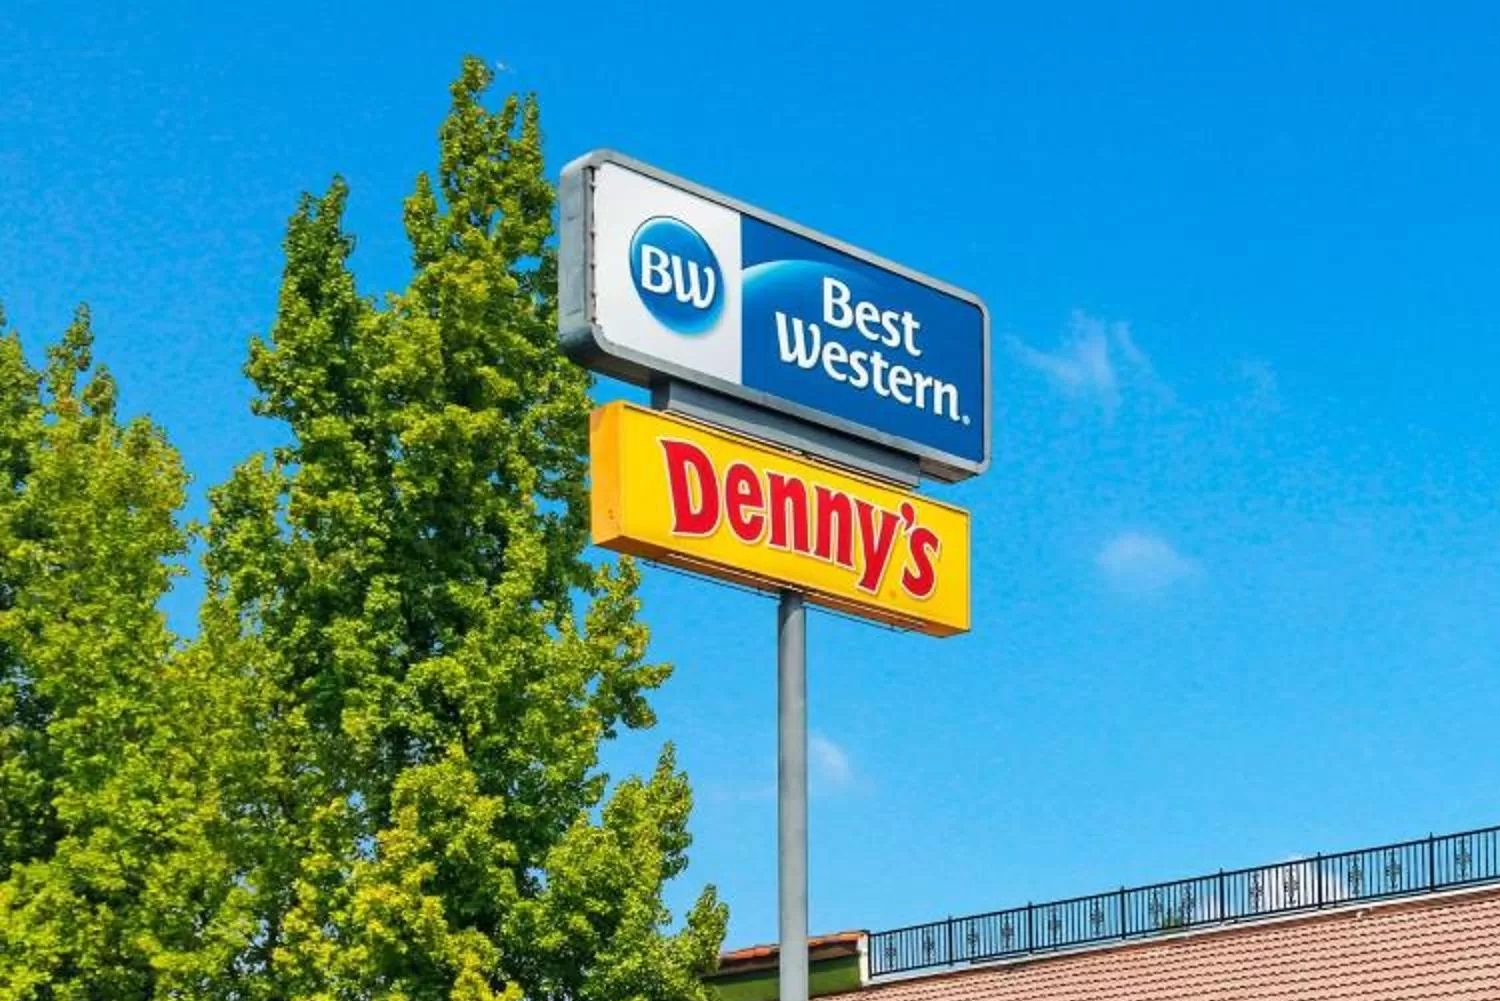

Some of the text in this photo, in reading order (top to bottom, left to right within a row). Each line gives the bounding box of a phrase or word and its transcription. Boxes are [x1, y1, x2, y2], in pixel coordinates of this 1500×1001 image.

[639, 244, 717, 310] BW
[822, 277, 922, 356] Best
[660, 439, 942, 599] Denny's
